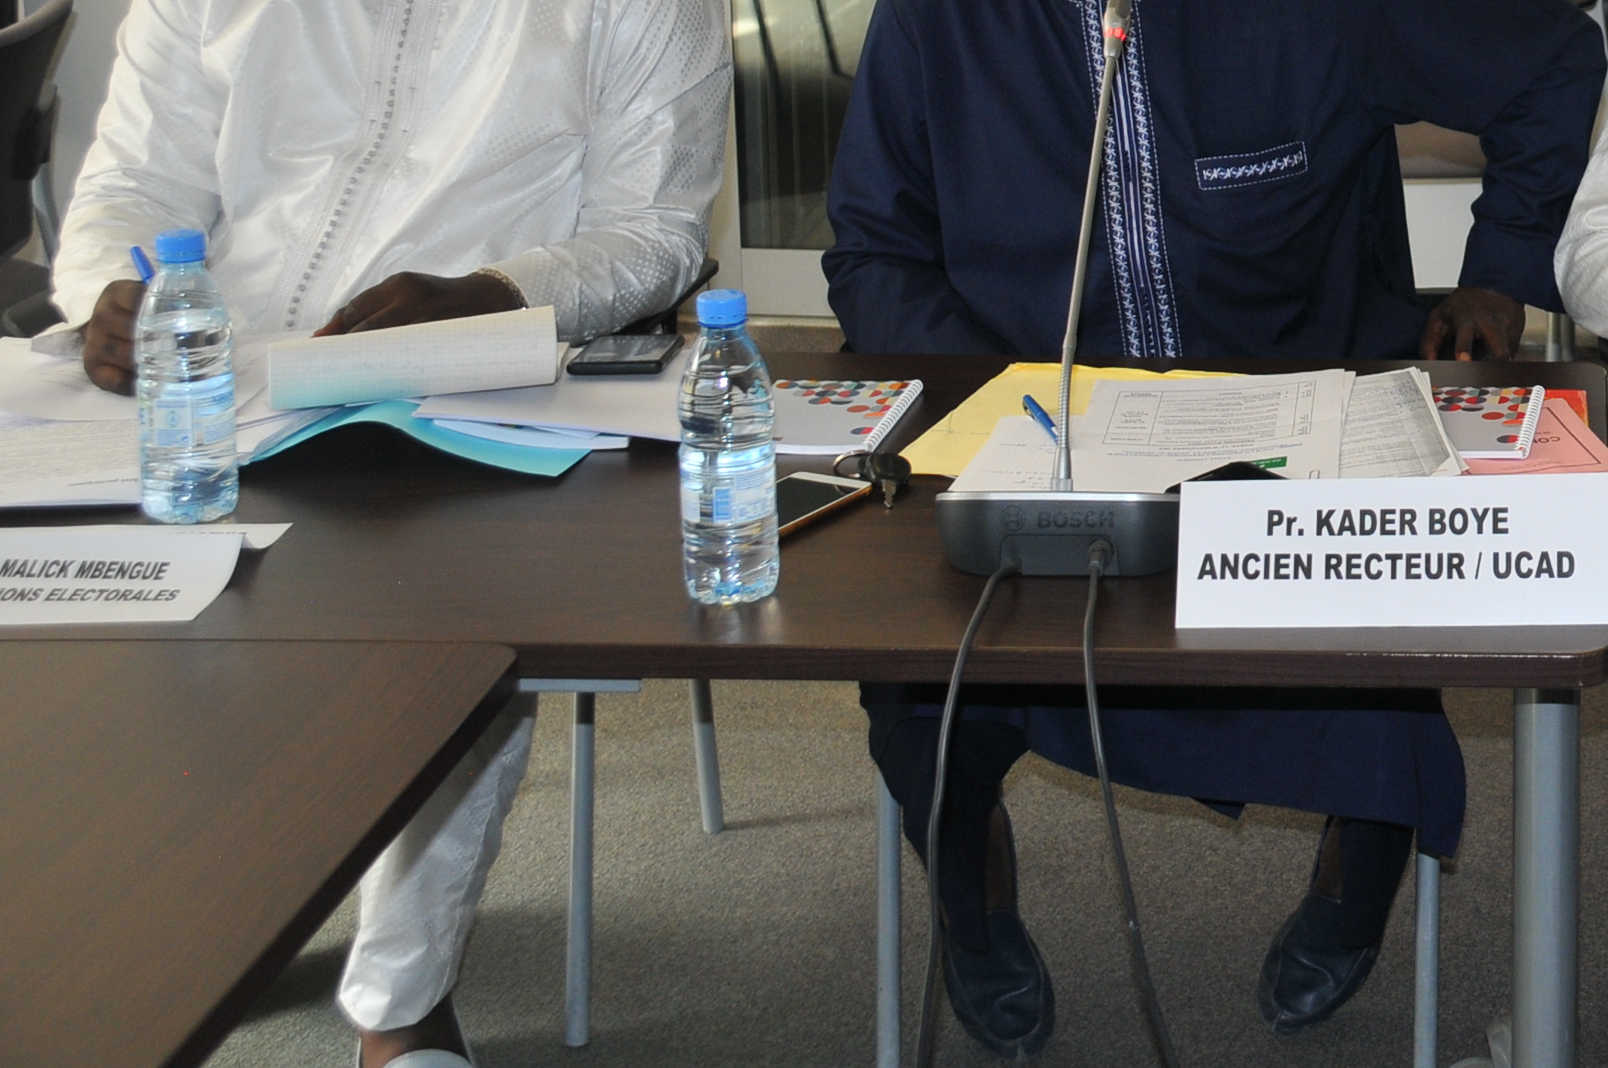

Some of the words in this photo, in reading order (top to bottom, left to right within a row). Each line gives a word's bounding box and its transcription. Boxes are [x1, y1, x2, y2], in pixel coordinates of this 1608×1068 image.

[1036, 510, 1115, 529] BOSCH
[1265, 509, 1305, 536] Pr.
[1315, 509, 1418, 536] KADER
[1428, 507, 1510, 535] BOYE
[0, 559, 76, 578] MALICK
[74, 560, 171, 580] MBENGUE
[1197, 552, 1314, 581] ANCIEN
[1324, 552, 1467, 581] RECTEUR
[1491, 550, 1576, 580] UCAD
[0, 587, 45, 602] IONS
[44, 588, 181, 602] ELECTORALES
